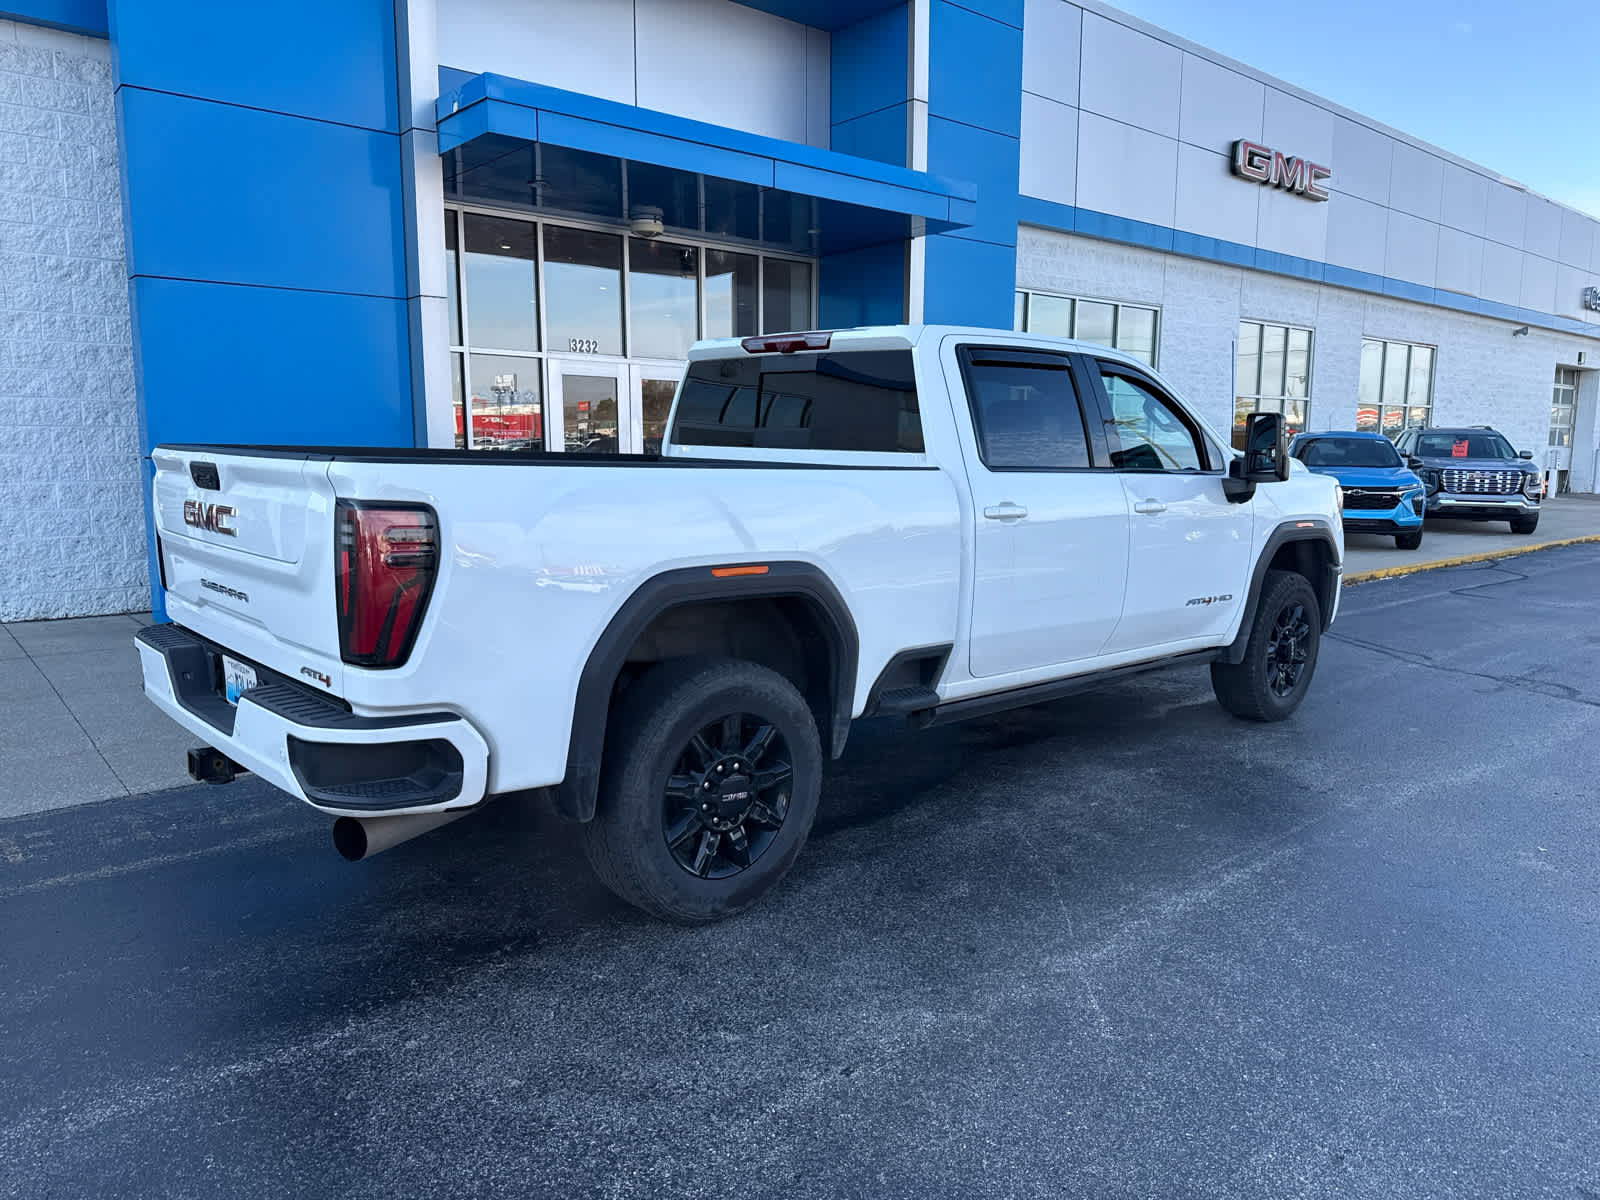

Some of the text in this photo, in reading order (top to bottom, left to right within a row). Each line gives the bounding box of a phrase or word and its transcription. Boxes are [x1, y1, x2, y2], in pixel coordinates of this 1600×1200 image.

[1232, 139, 1331, 201] GMC
[184, 500, 238, 536] GMC
[200, 578, 249, 603] SIERRA
[300, 666, 332, 688] AT4
